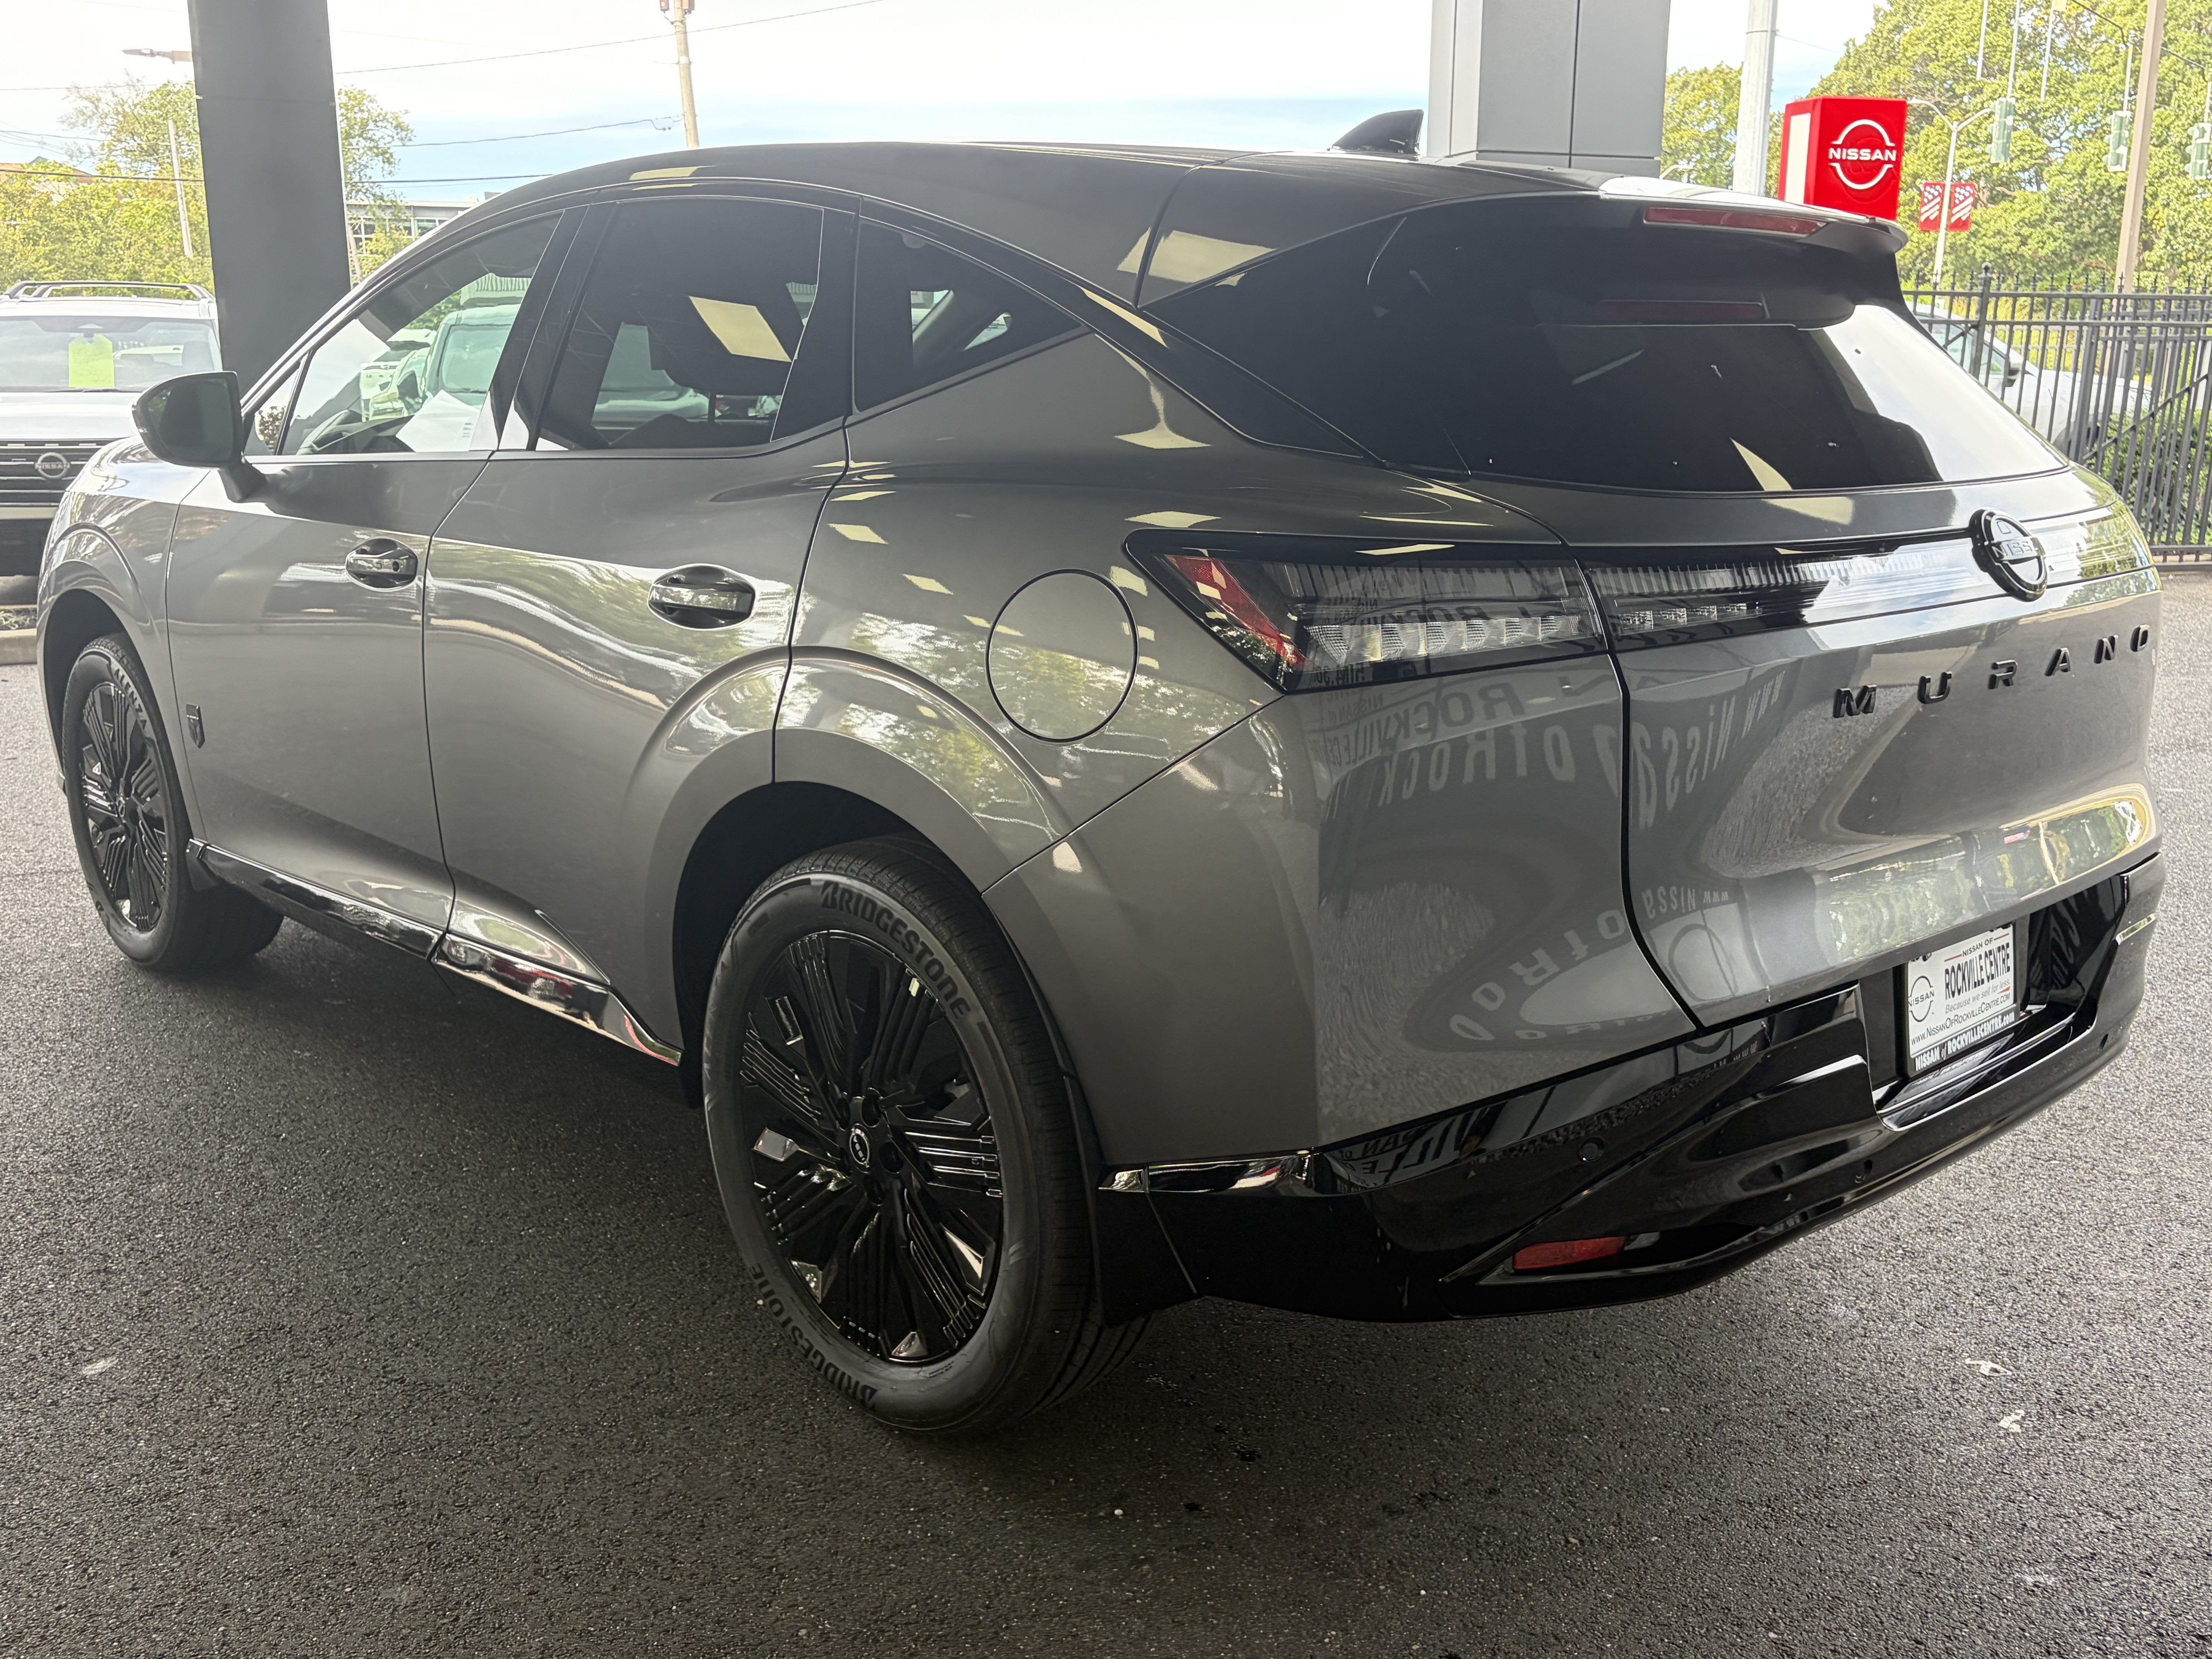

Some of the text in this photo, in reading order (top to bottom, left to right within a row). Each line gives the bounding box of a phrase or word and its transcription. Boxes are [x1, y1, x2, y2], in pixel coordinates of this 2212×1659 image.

[1829, 147, 1896, 162] NISSAN
[1991, 541, 2045, 558] NISS
[1832, 624, 2151, 719] MURANO
[114, 668, 147, 730] ALENZA
[821, 881, 971, 1020] BRIDGESTONE
[1963, 937, 1994, 957] NISSAN OF
[1945, 942, 2010, 1000] ROCKVILLE CENTRE
[1908, 989, 1934, 1007] NISSAN
[1945, 998, 1970, 1013] Because
[1972, 993, 1980, 1003] we
[1981, 989, 1990, 998] sell
[1915, 1046, 1940, 1071] NISSAN
[1941, 1042, 1947, 1060] of
[750, 1264, 879, 1411] BRIDGESTONE
